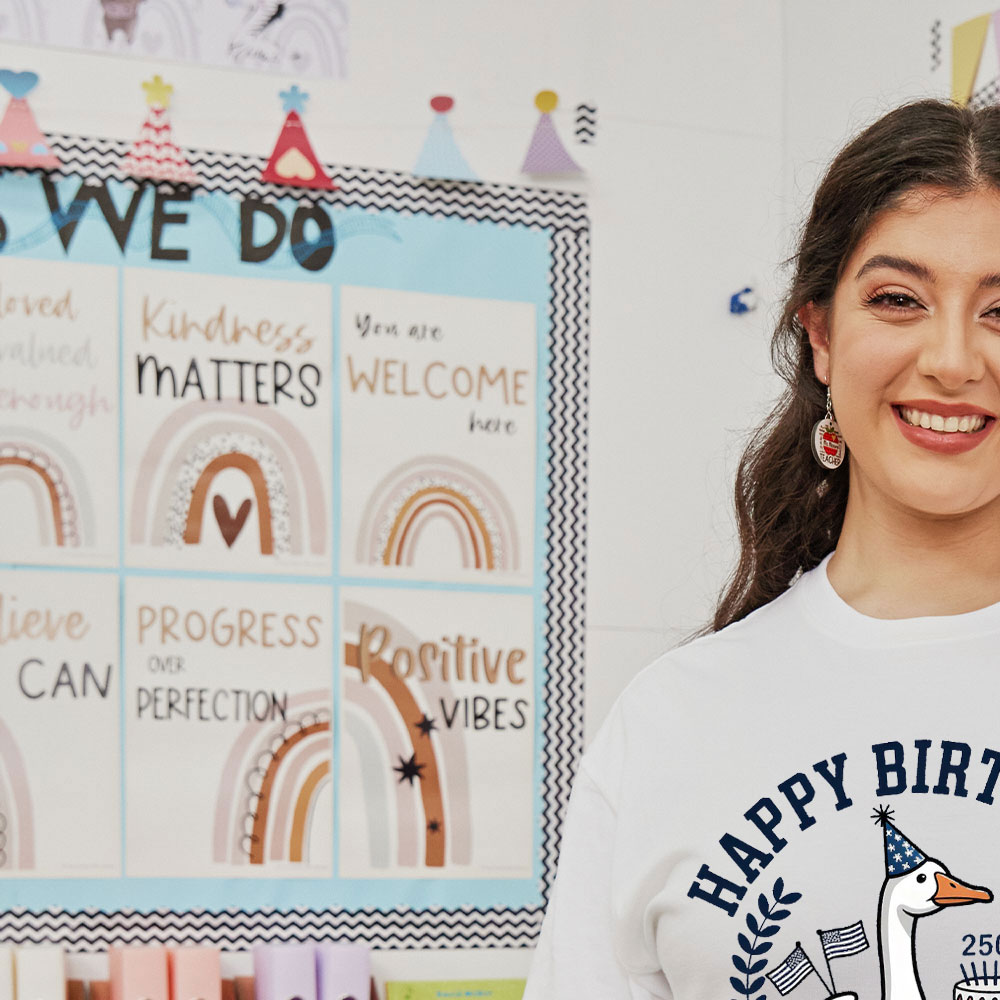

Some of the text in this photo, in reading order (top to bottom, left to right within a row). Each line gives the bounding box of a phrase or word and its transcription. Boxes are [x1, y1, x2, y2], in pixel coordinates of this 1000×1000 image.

[40, 176, 193, 260] WE
[240, 199, 335, 272] DO
[141, 295, 317, 353] Kindness
[355, 313, 443, 341] You are
[346, 353, 530, 406] WELCOME
[468, 409, 518, 436] here
[136, 604, 323, 649] PROGRESS
[149, 655, 186, 675] OVER
[358, 623, 527, 685] Positive
[18, 658, 113, 700] CAN
[136, 686, 289, 722] PERFECTION
[439, 695, 529, 731] VIBES
[687, 752, 853, 917] HAPPY
